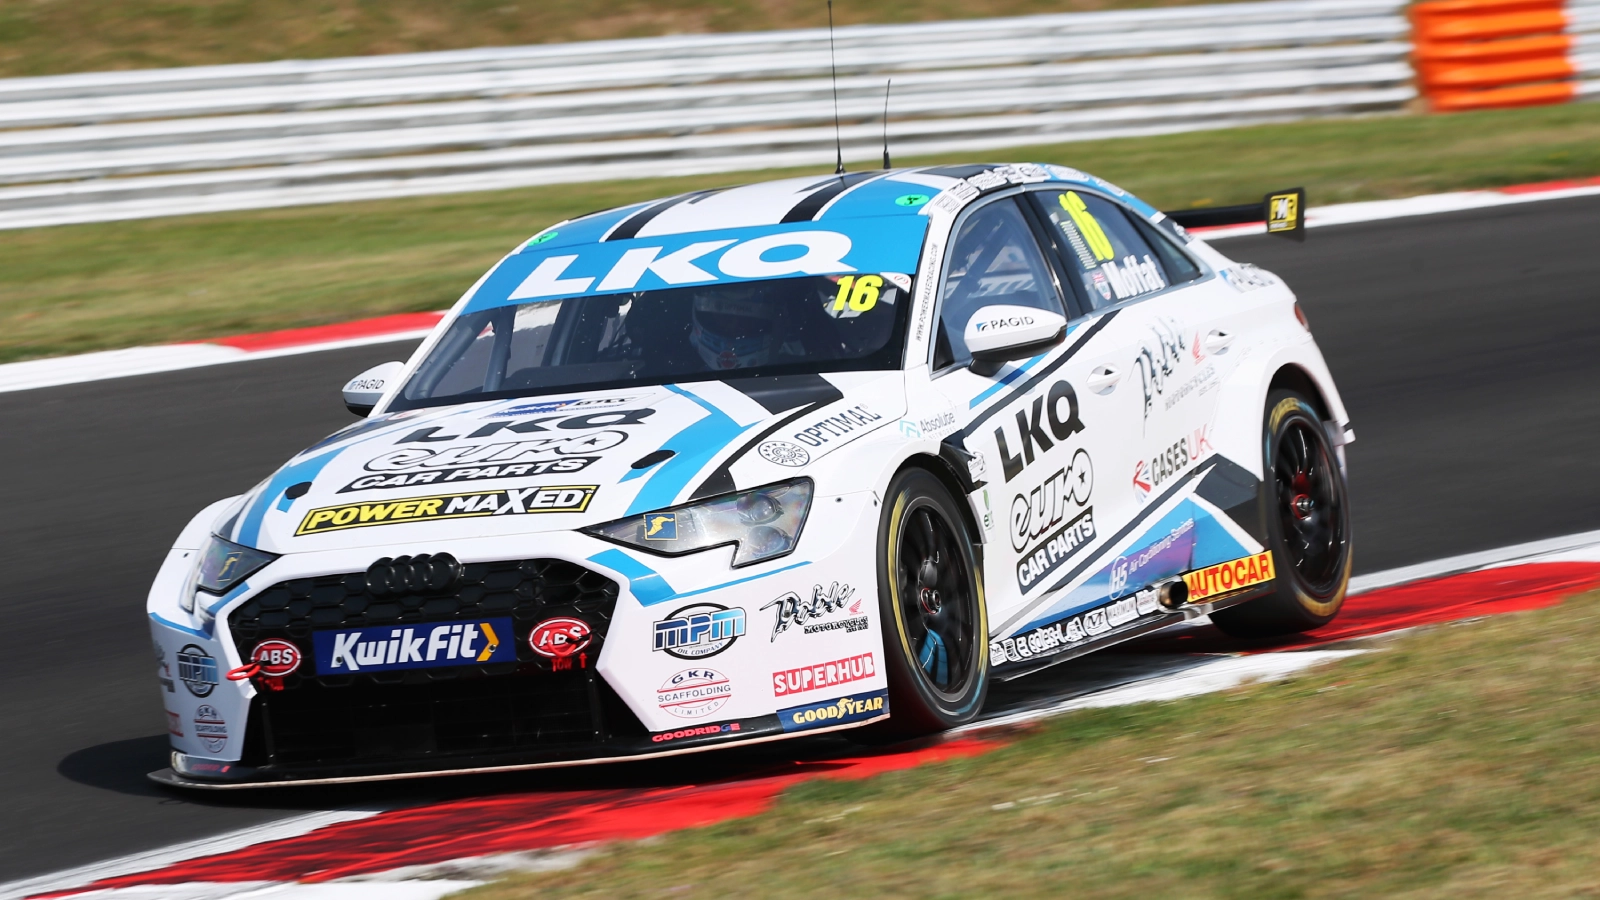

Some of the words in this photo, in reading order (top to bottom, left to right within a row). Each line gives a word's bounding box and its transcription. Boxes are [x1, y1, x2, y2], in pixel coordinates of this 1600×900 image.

[1059, 191, 1114, 261] 16
[507, 230, 858, 300] LKQ
[832, 275, 883, 311] 16
[990, 315, 1034, 330] PAGID
[355, 379, 385, 390] PAGID
[395, 407, 656, 445] LKQ
[794, 406, 882, 447] OPTIMAL
[920, 411, 956, 433] Absolute
[994, 380, 1086, 484] LKQ
[363, 430, 629, 473] euro
[350, 471, 435, 490] CAR
[447, 458, 589, 482] PARTS
[308, 499, 445, 529] POWER
[444, 485, 585, 515] MAXED
[1010, 448, 1093, 553] euro
[1018, 549, 1050, 586] CAR
[1048, 514, 1095, 565] PARTS
[1189, 554, 1272, 600] AUTOCAR
[539, 626, 583, 647] ABS
[677, 647, 689, 655] OIL
[691, 641, 724, 656] COMPANY
[259, 649, 293, 665] ABS
[551, 657, 572, 671] TOW
[672, 670, 715, 684] GKR
[774, 653, 875, 696] SUPERHUB
[658, 684, 731, 703] SCAFFOLDING
[674, 701, 719, 715] LIMITED
[652, 723, 741, 743] GOODRIDGE
